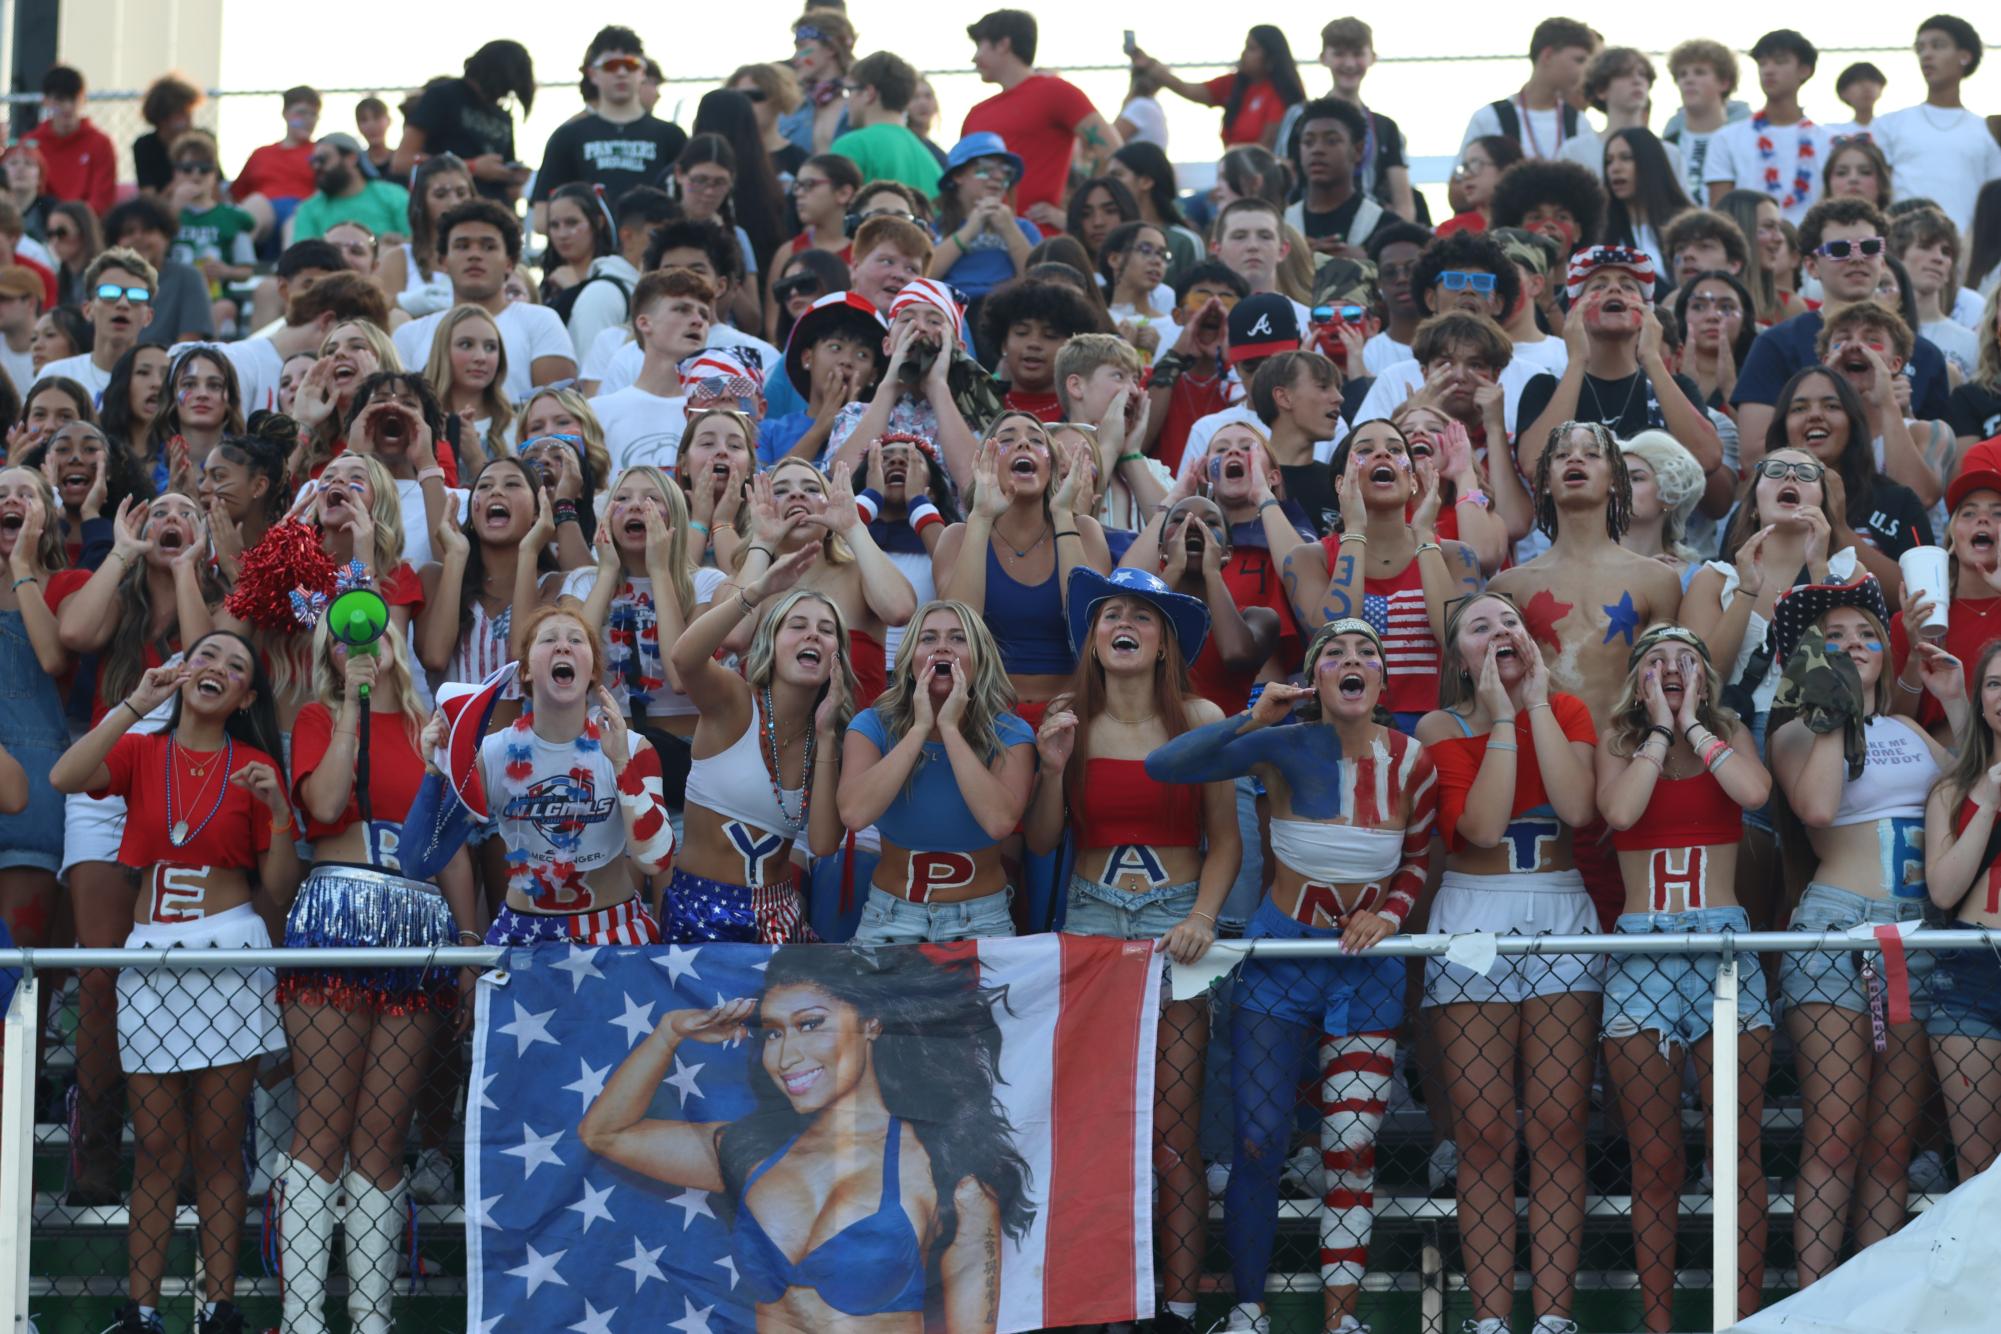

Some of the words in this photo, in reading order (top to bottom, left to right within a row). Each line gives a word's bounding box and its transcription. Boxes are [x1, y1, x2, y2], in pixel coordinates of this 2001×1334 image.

[1247, 313, 1273, 337] A
[1889, 738, 1908, 747] ME
[721, 820, 784, 888] Y
[1099, 845, 1170, 887] A
[1500, 817, 1561, 873] T
[150, 860, 211, 925] E
[906, 850, 976, 904] P
[1649, 846, 1708, 913] H
